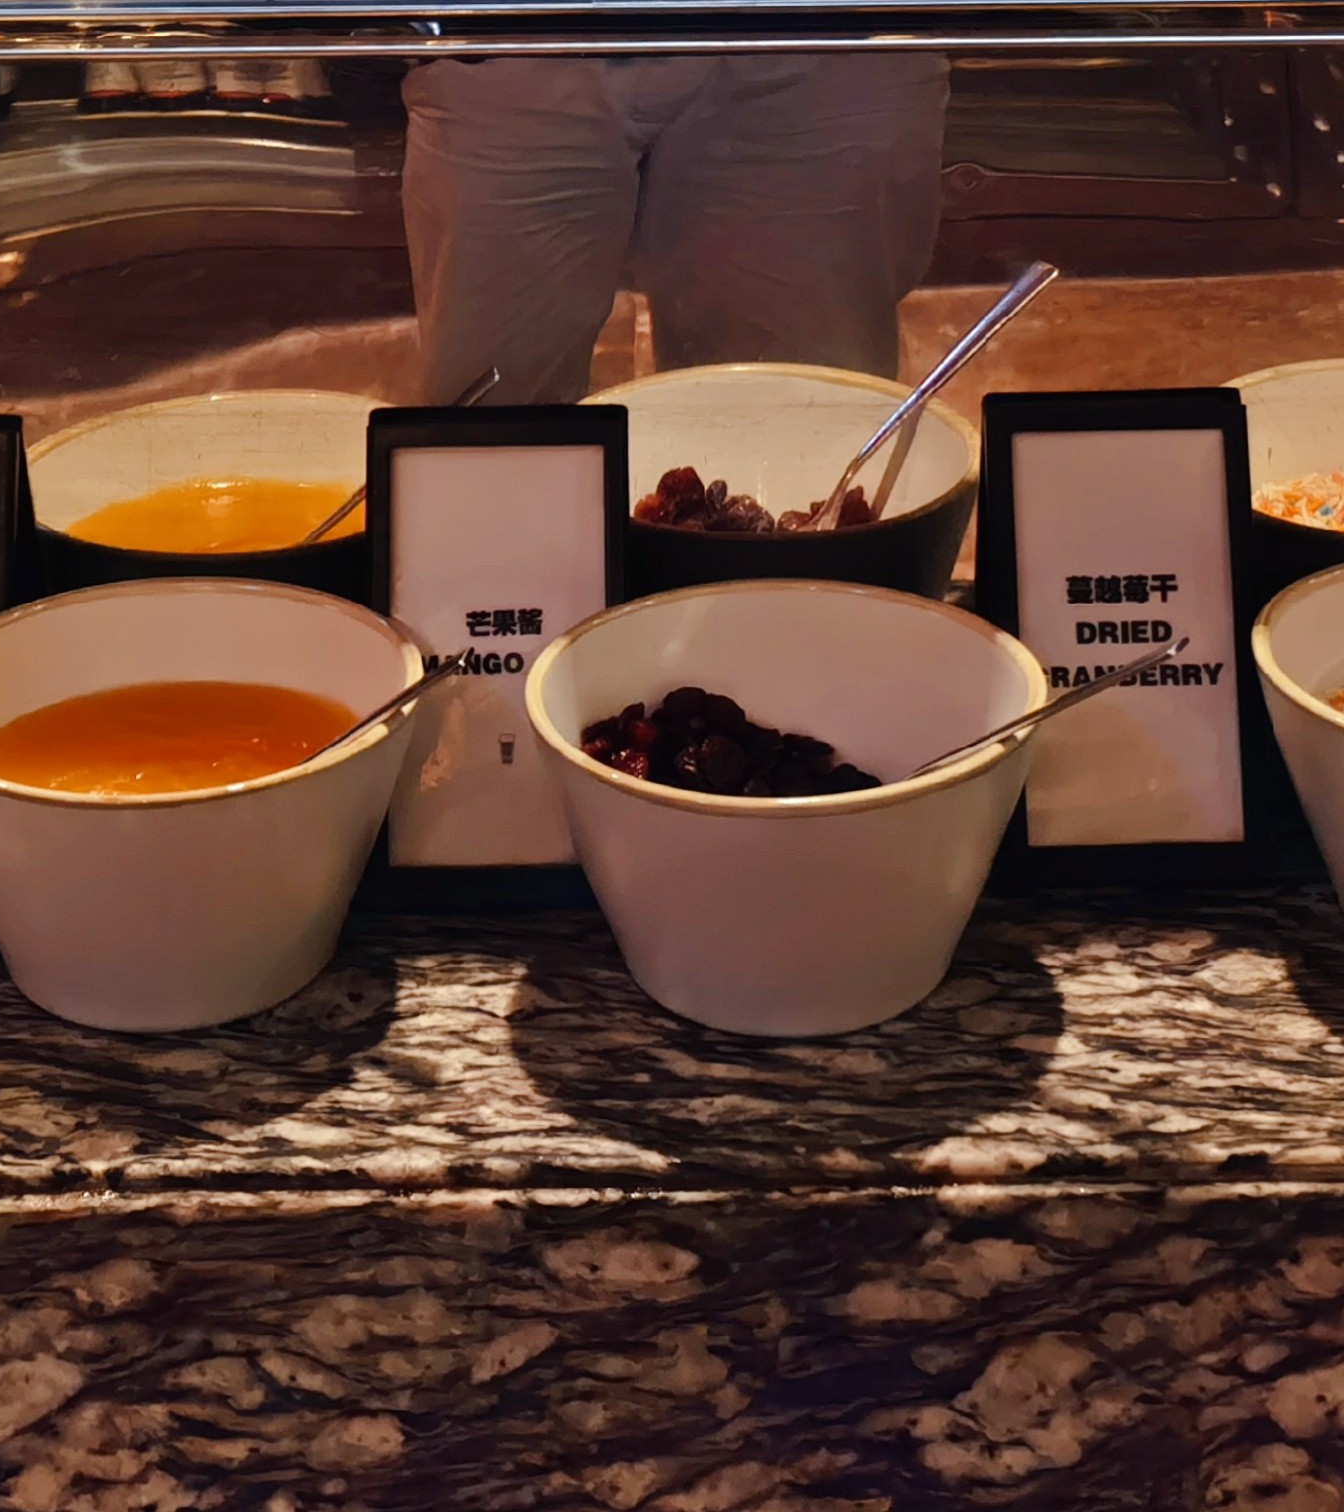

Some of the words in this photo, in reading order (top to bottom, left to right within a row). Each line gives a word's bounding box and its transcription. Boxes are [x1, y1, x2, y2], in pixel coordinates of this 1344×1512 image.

[1065, 574, 1178, 604] 蔓越莓干
[465, 609, 543, 636] 芒果酱
[1075, 620, 1173, 644] DRIED
